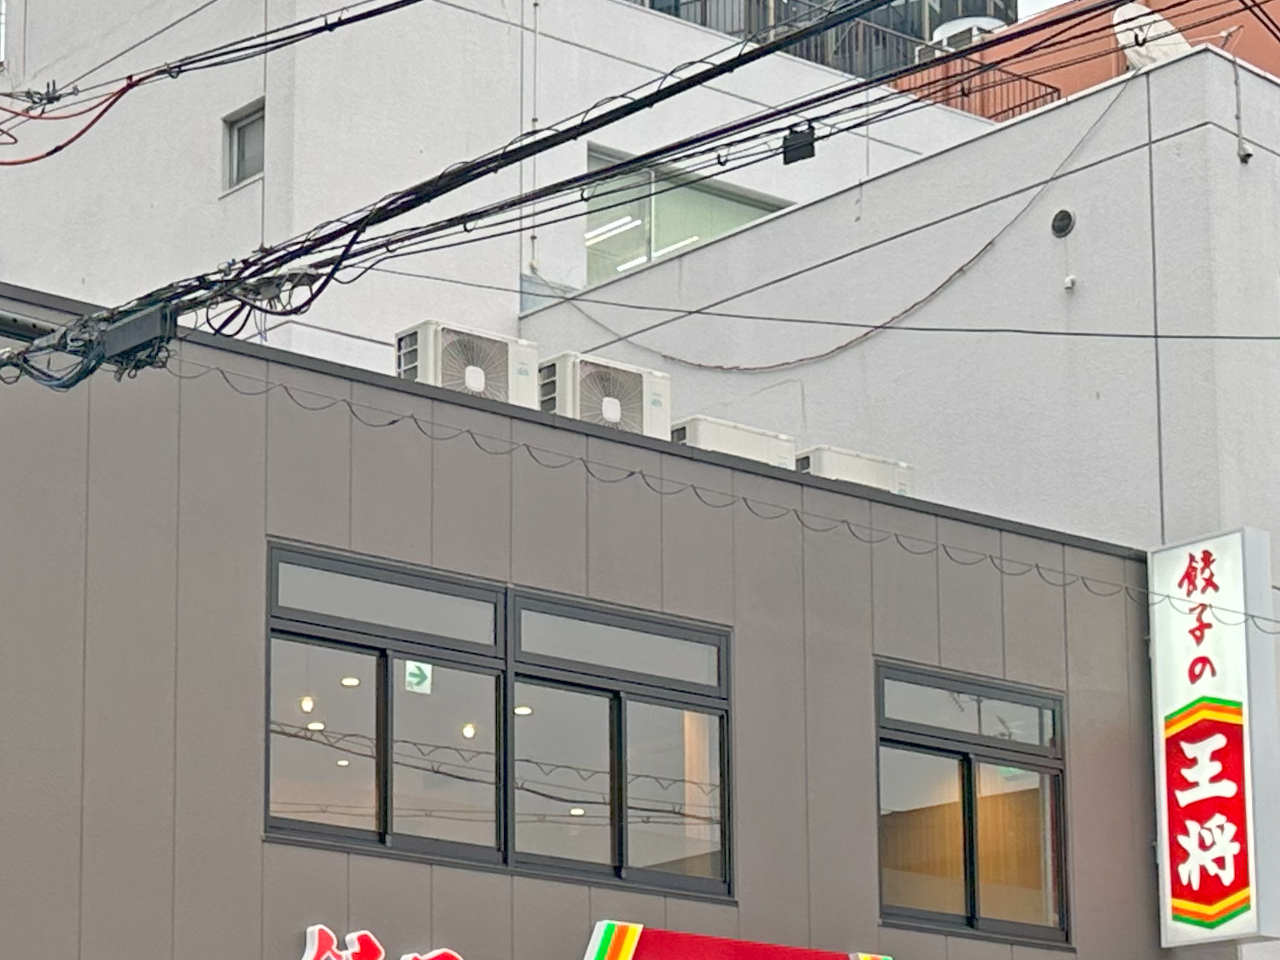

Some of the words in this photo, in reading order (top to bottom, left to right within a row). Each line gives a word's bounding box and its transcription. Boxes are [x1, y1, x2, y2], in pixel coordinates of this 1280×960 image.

[1178, 549, 1220, 685] 餃子の
[1174, 732, 1240, 891] 王将
